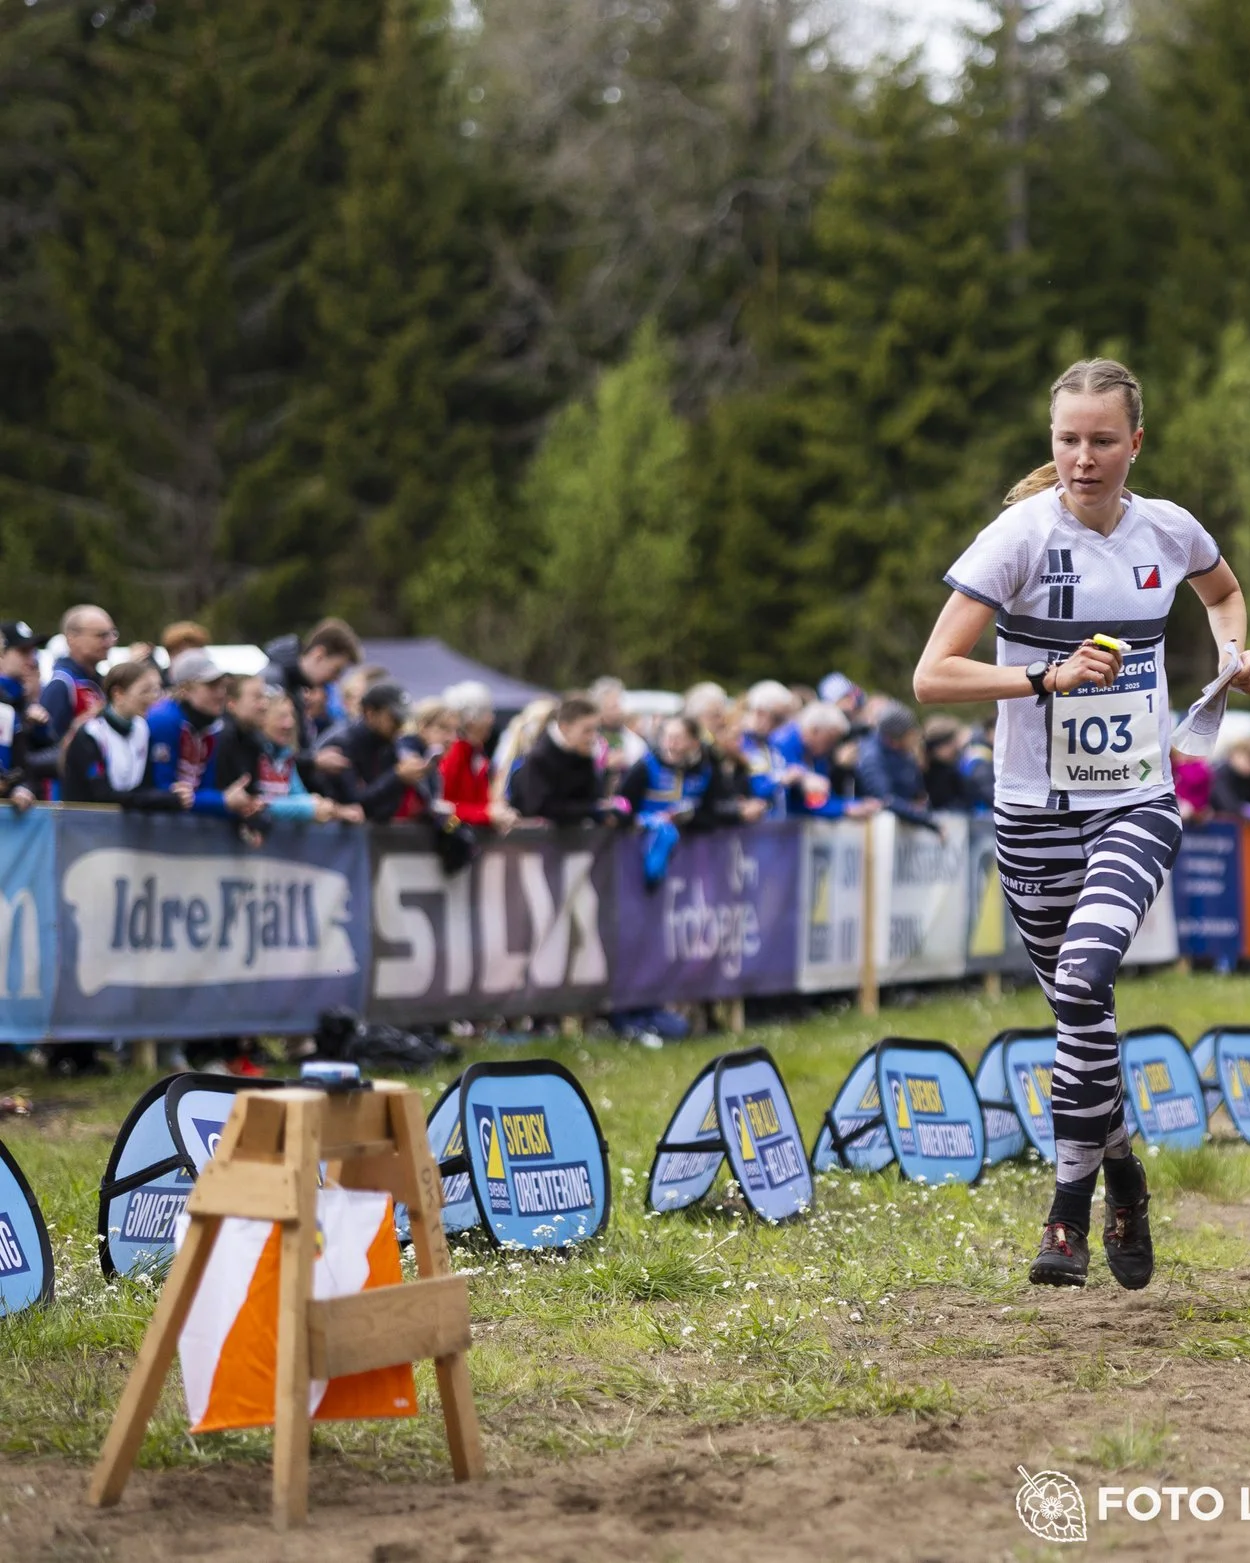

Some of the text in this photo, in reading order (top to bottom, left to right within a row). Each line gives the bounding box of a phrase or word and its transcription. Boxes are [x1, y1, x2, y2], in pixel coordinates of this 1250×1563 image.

[1040, 574, 1082, 584] TRIMTEX
[1091, 684, 1121, 693] STAFETT
[1146, 693, 1153, 713] 1
[1062, 714, 1133, 755] 103
[1066, 764, 1130, 781] Valmet
[502, 1114, 551, 1156] SVENSK
[918, 1122, 975, 1158] ORIENTERING
[514, 1166, 592, 1213] ORIENTERING
